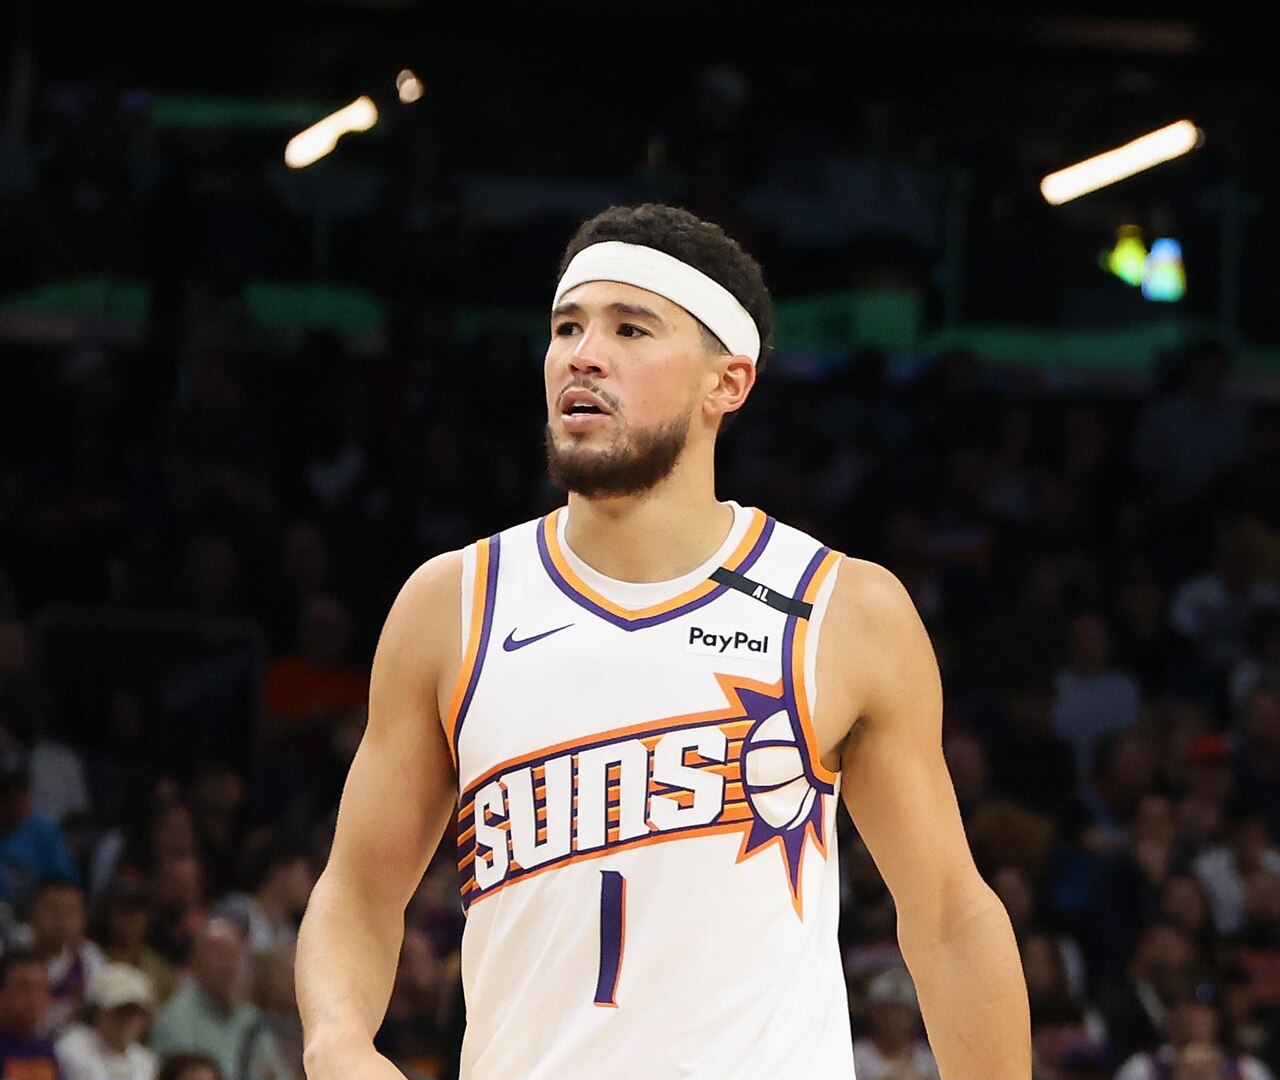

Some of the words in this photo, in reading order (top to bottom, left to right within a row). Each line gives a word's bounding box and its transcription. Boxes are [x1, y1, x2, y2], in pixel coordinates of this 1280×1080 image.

[752, 585, 768, 602] AL
[689, 626, 768, 653] PayPal
[474, 725, 727, 890] SUNS
[594, 870, 626, 1009] 1
